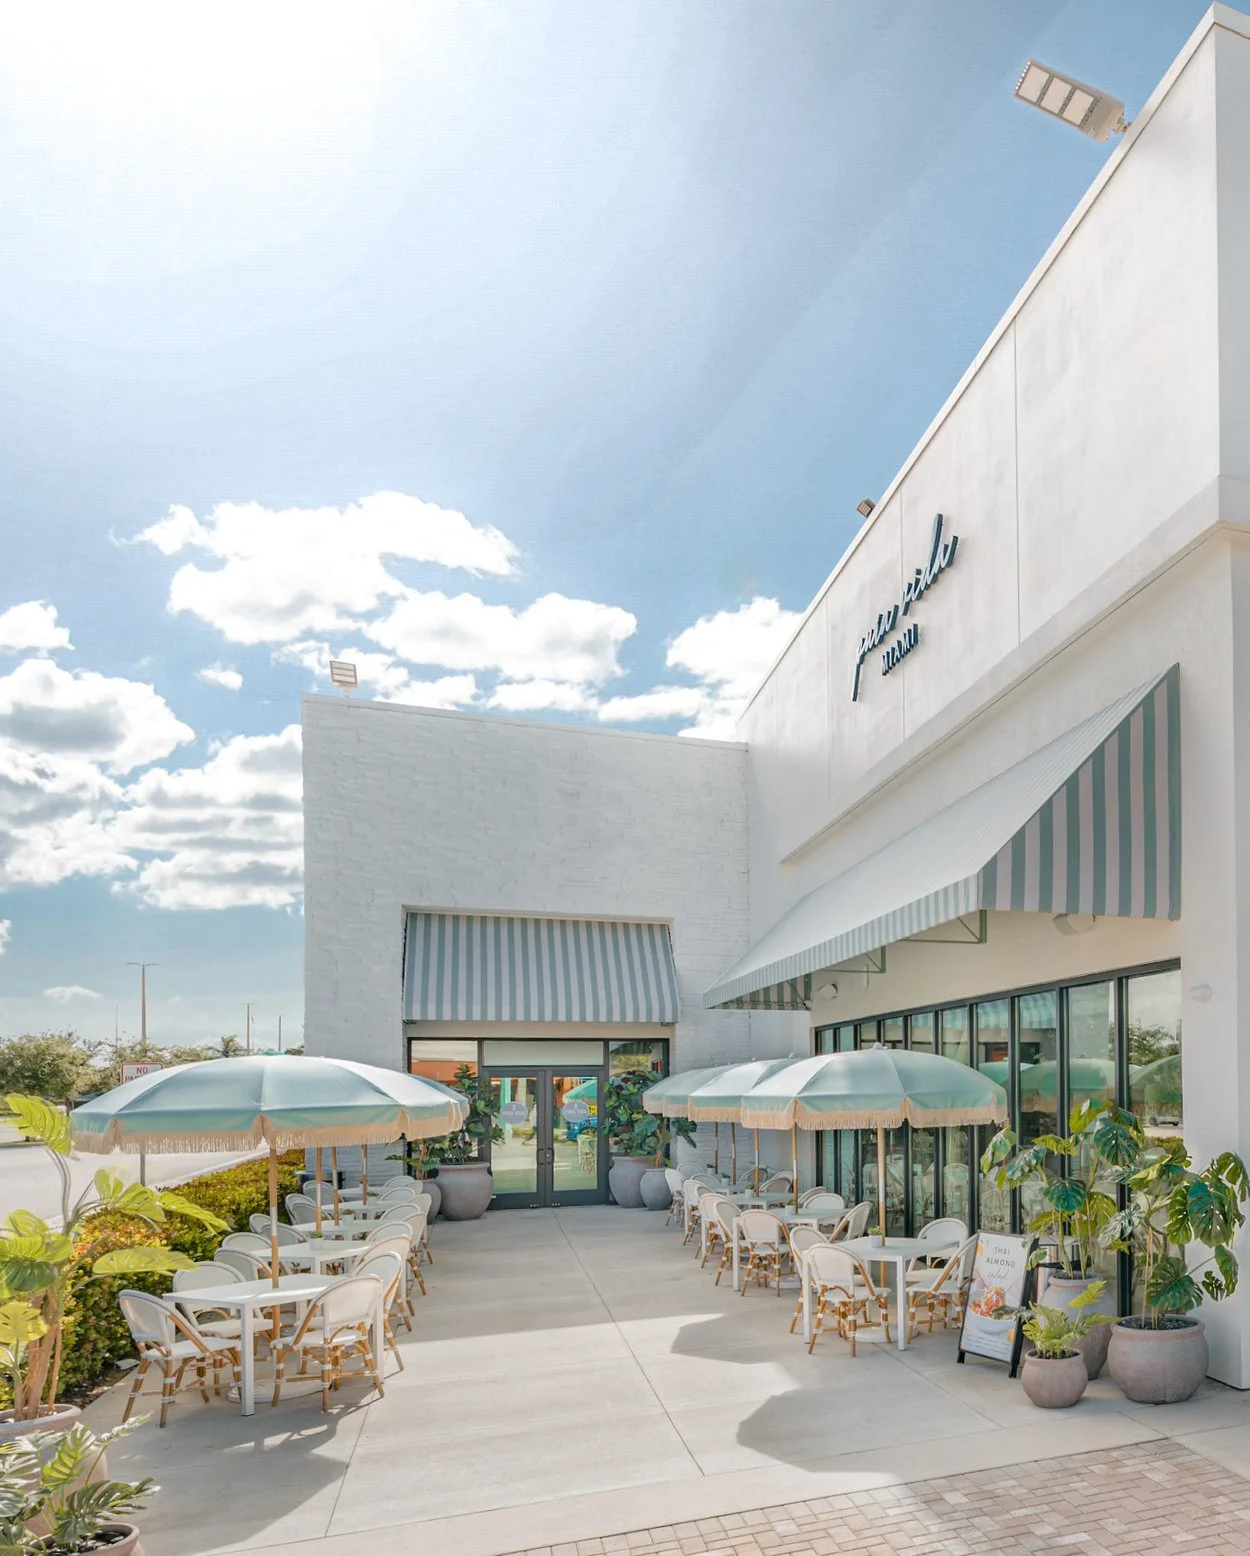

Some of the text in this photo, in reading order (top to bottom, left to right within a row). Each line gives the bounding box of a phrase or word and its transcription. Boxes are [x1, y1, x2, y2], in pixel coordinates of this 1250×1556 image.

[881, 623, 919, 677] MIAMI
[136, 1066, 148, 1074] NO
[994, 1246, 1010, 1256] THAI
[985, 1256, 1016, 1268] ALMOND
